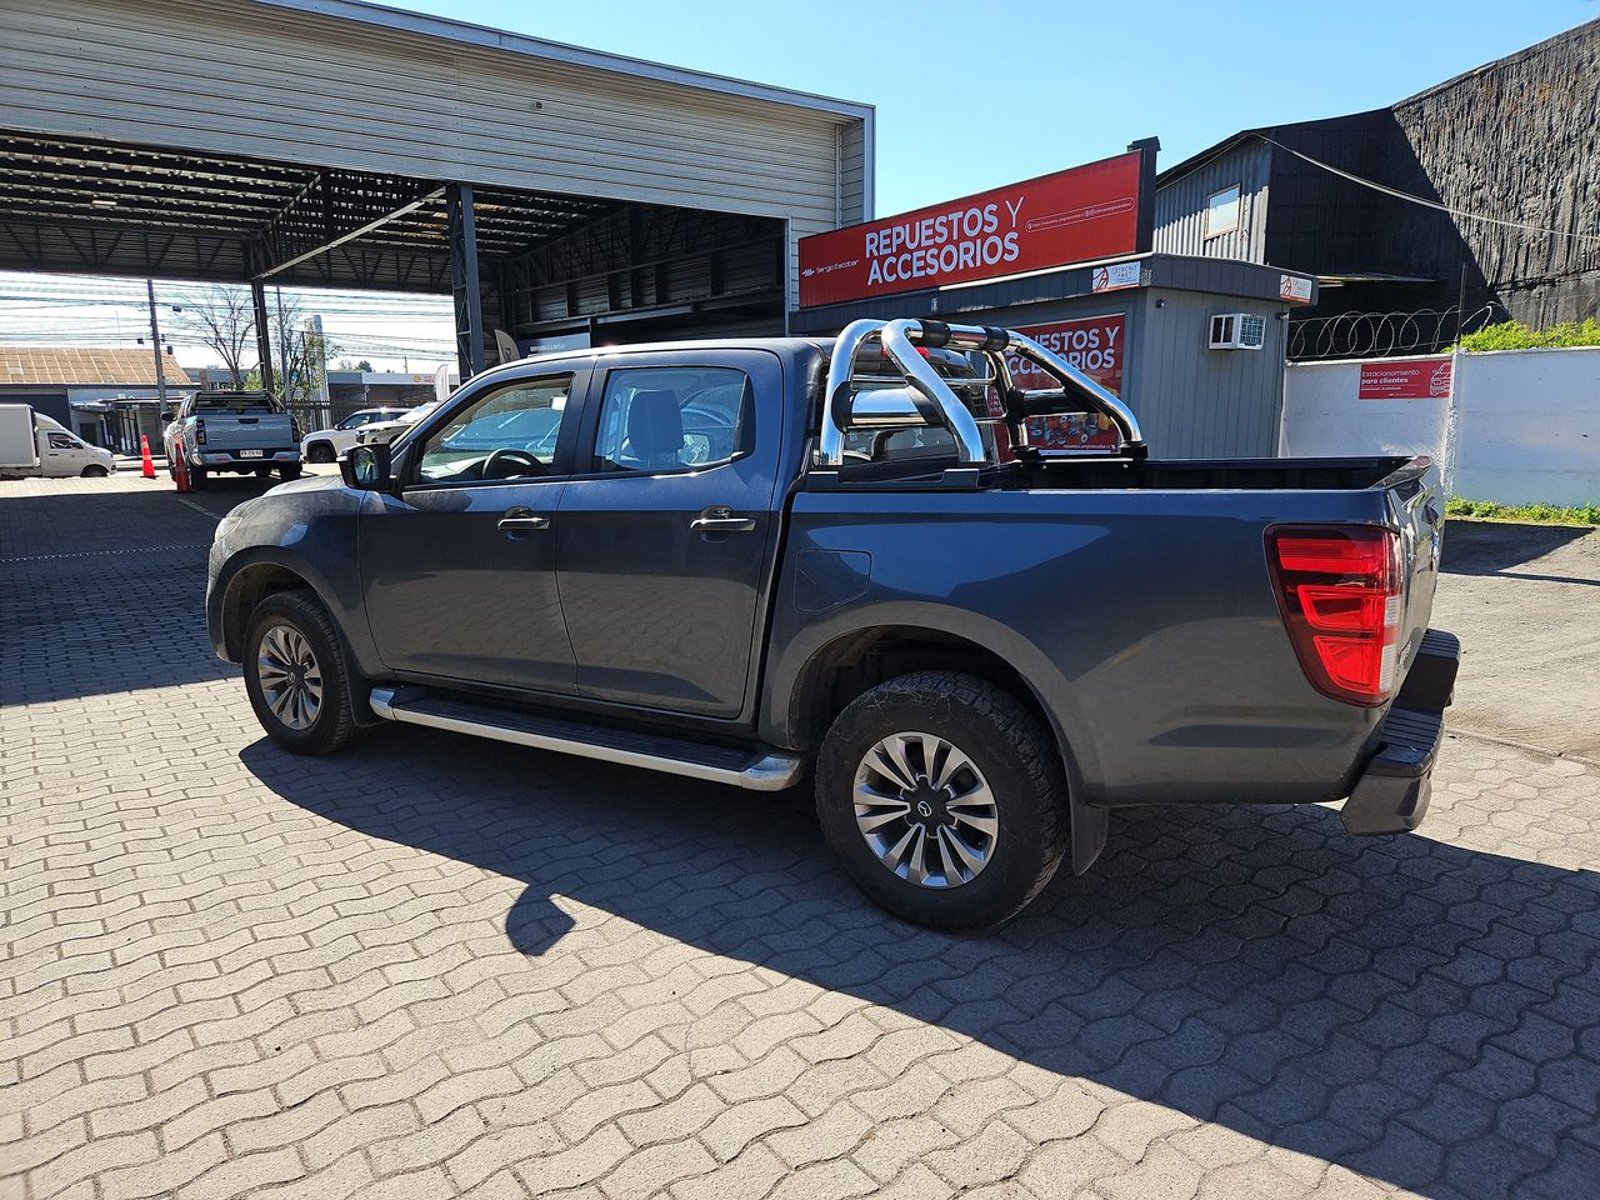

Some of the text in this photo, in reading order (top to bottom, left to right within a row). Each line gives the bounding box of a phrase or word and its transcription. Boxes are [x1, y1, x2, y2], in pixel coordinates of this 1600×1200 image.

[866, 203, 998, 258] REPUESTOS
[1005, 196, 1024, 228] Y
[867, 231, 1020, 286] ACCESORIOS
[1105, 326, 1120, 347] Y
[1362, 369, 1420, 377] Estacionamiento
